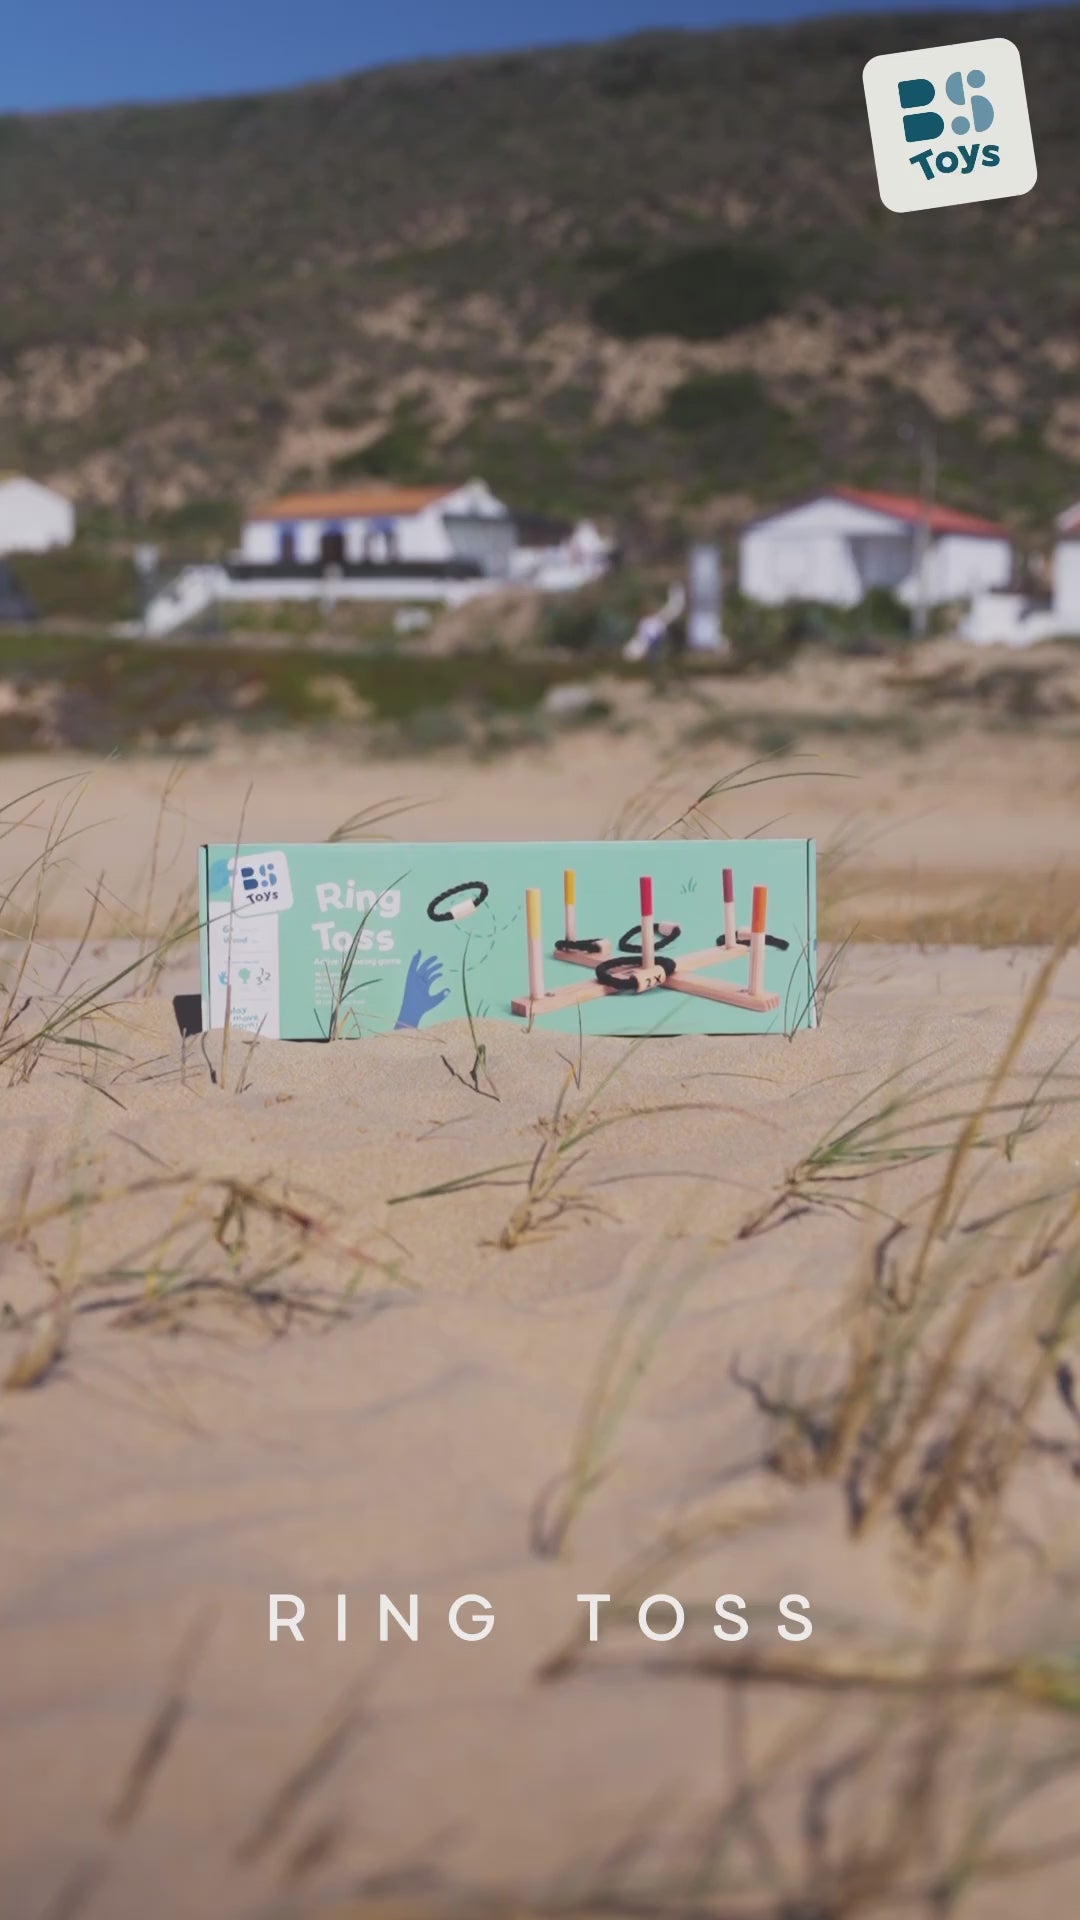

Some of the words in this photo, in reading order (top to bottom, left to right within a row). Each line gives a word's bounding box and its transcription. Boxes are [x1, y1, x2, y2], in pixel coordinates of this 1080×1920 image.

[241, 863, 277, 891] BS
[246, 891, 279, 904] Toys
[316, 880, 401, 918] Ring
[312, 921, 395, 952] Toss
[230, 1007, 248, 1015] lay
